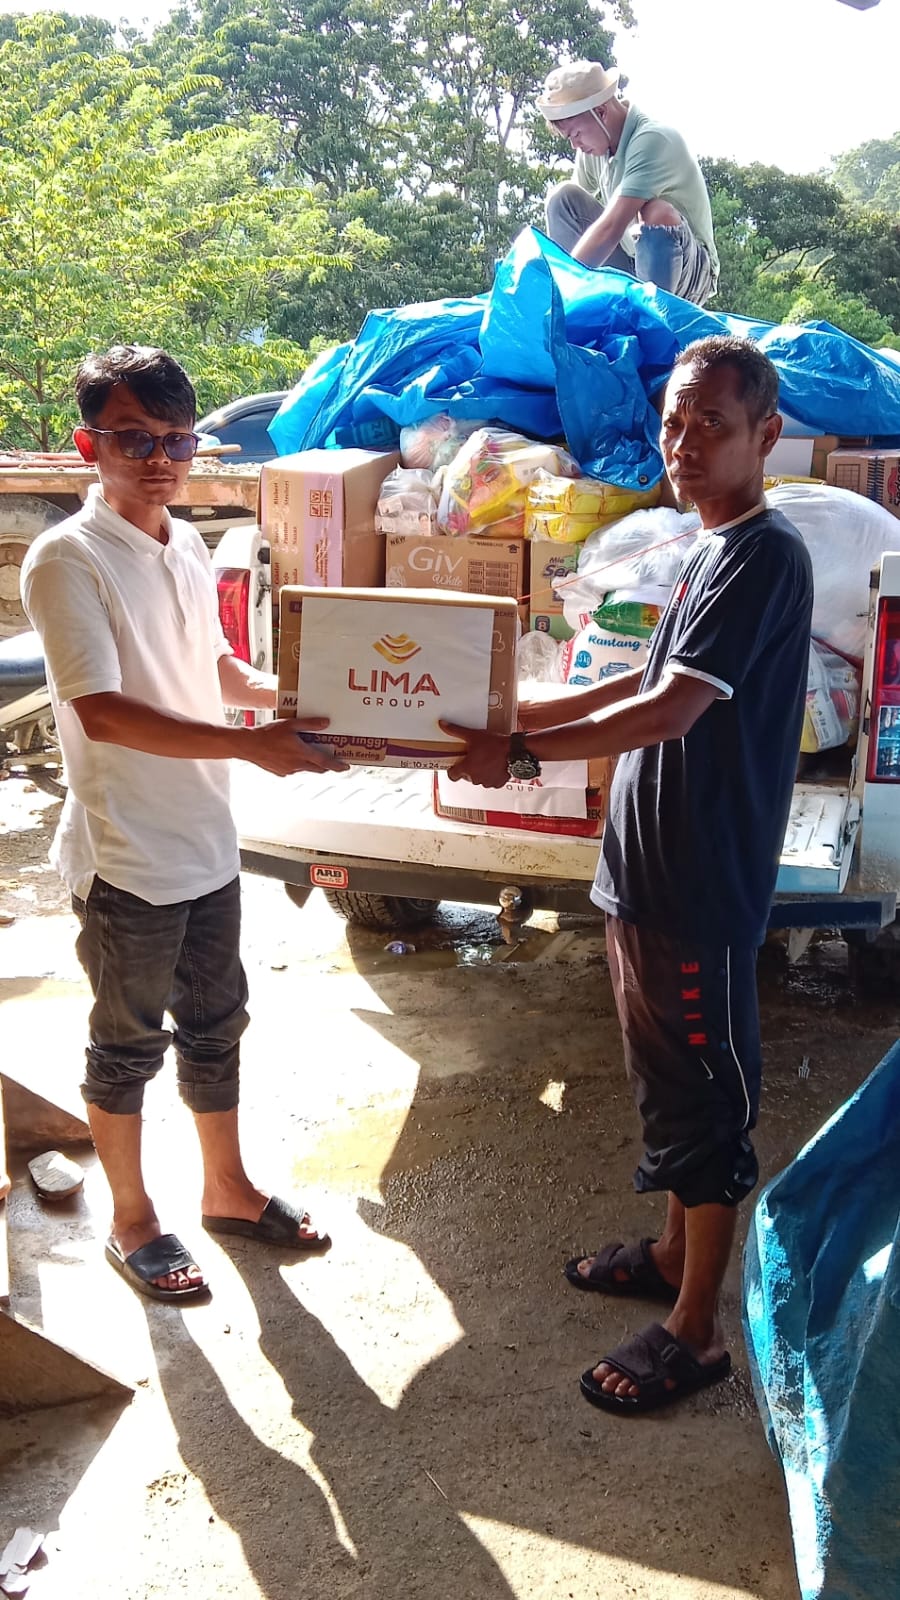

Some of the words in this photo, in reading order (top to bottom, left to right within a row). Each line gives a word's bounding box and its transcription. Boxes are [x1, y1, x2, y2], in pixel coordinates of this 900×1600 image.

[390, 536, 406, 546] NEW
[408, 546, 464, 574] Giv
[549, 556, 565, 564] Mie
[588, 634, 641, 652] Rantang
[348, 668, 441, 696] LIMA
[282, 696, 298, 706] MA
[362, 696, 425, 709] GROUP
[315, 734, 348, 746] Serap
[350, 736, 386, 749] Tinggi
[355, 751, 380, 761] Kering
[413, 761, 422, 769] 10
[506, 784, 534, 792] OUP
[316, 868, 342, 878] ARB
[681, 961, 707, 1045] NIKE
